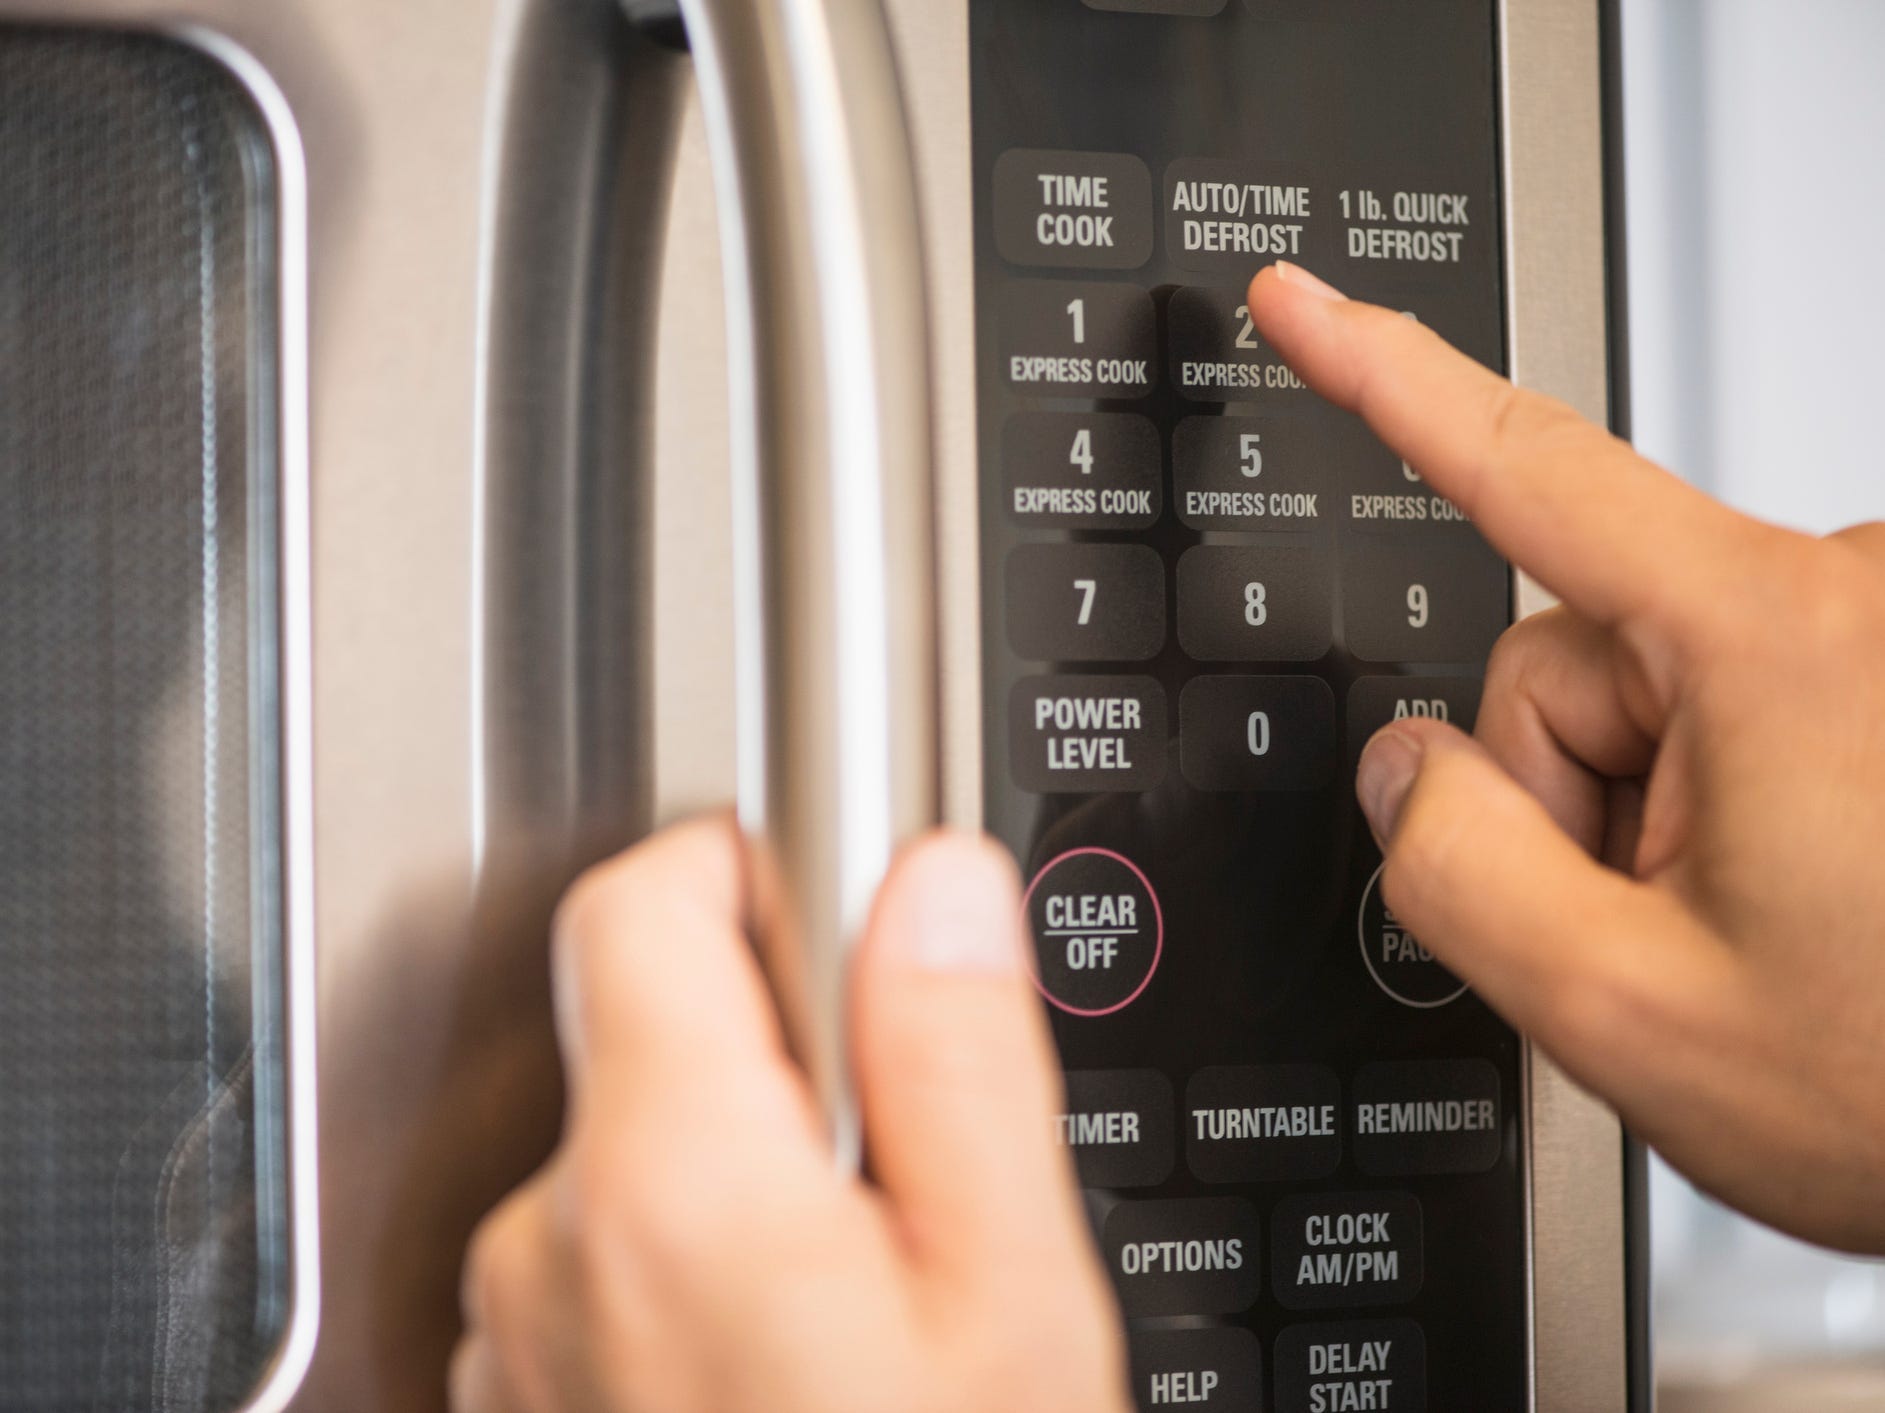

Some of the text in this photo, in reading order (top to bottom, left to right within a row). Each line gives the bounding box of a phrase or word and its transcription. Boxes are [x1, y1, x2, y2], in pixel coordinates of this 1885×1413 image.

[1038, 175, 1108, 207] TIME
[1173, 182, 1310, 219] AUTO/TIME
[1340, 191, 1468, 224] 1 lb. QUICK
[1037, 214, 1113, 246] COOK
[1184, 219, 1302, 254] DEFROST
[1349, 228, 1462, 261] DEFROST
[1068, 299, 1084, 343] 1
[1235, 306, 1258, 349] 2
[1011, 357, 1146, 383] EXPRESS COOK
[1183, 363, 1306, 388] EXPRESS COO
[1070, 430, 1093, 473] 4
[1241, 434, 1261, 477] 5
[1014, 488, 1150, 513] EXPRESS COOK
[1187, 492, 1317, 517] EXPRESS COOK
[1352, 495, 1426, 519] EXPRESS
[1074, 580, 1095, 624] 7
[1245, 582, 1266, 625] 8
[1407, 585, 1428, 627] 9
[1036, 698, 1140, 730] POWER
[1248, 712, 1269, 755] 0
[1048, 738, 1131, 769] LEVEL
[1046, 896, 1136, 928] CLEAR
[1067, 937, 1117, 969] OFF
[1051, 1112, 1140, 1146] TIMER
[1193, 1106, 1334, 1139] TURNTABLE
[1359, 1101, 1493, 1133] REMINDER
[1306, 1213, 1389, 1245] CLOCK
[1122, 1239, 1242, 1274] OPTIONS
[1297, 1251, 1397, 1286] AM/PM
[1310, 1341, 1391, 1374] DELAY
[1152, 1371, 1217, 1403] HELP
[1310, 1380, 1392, 1413] START
